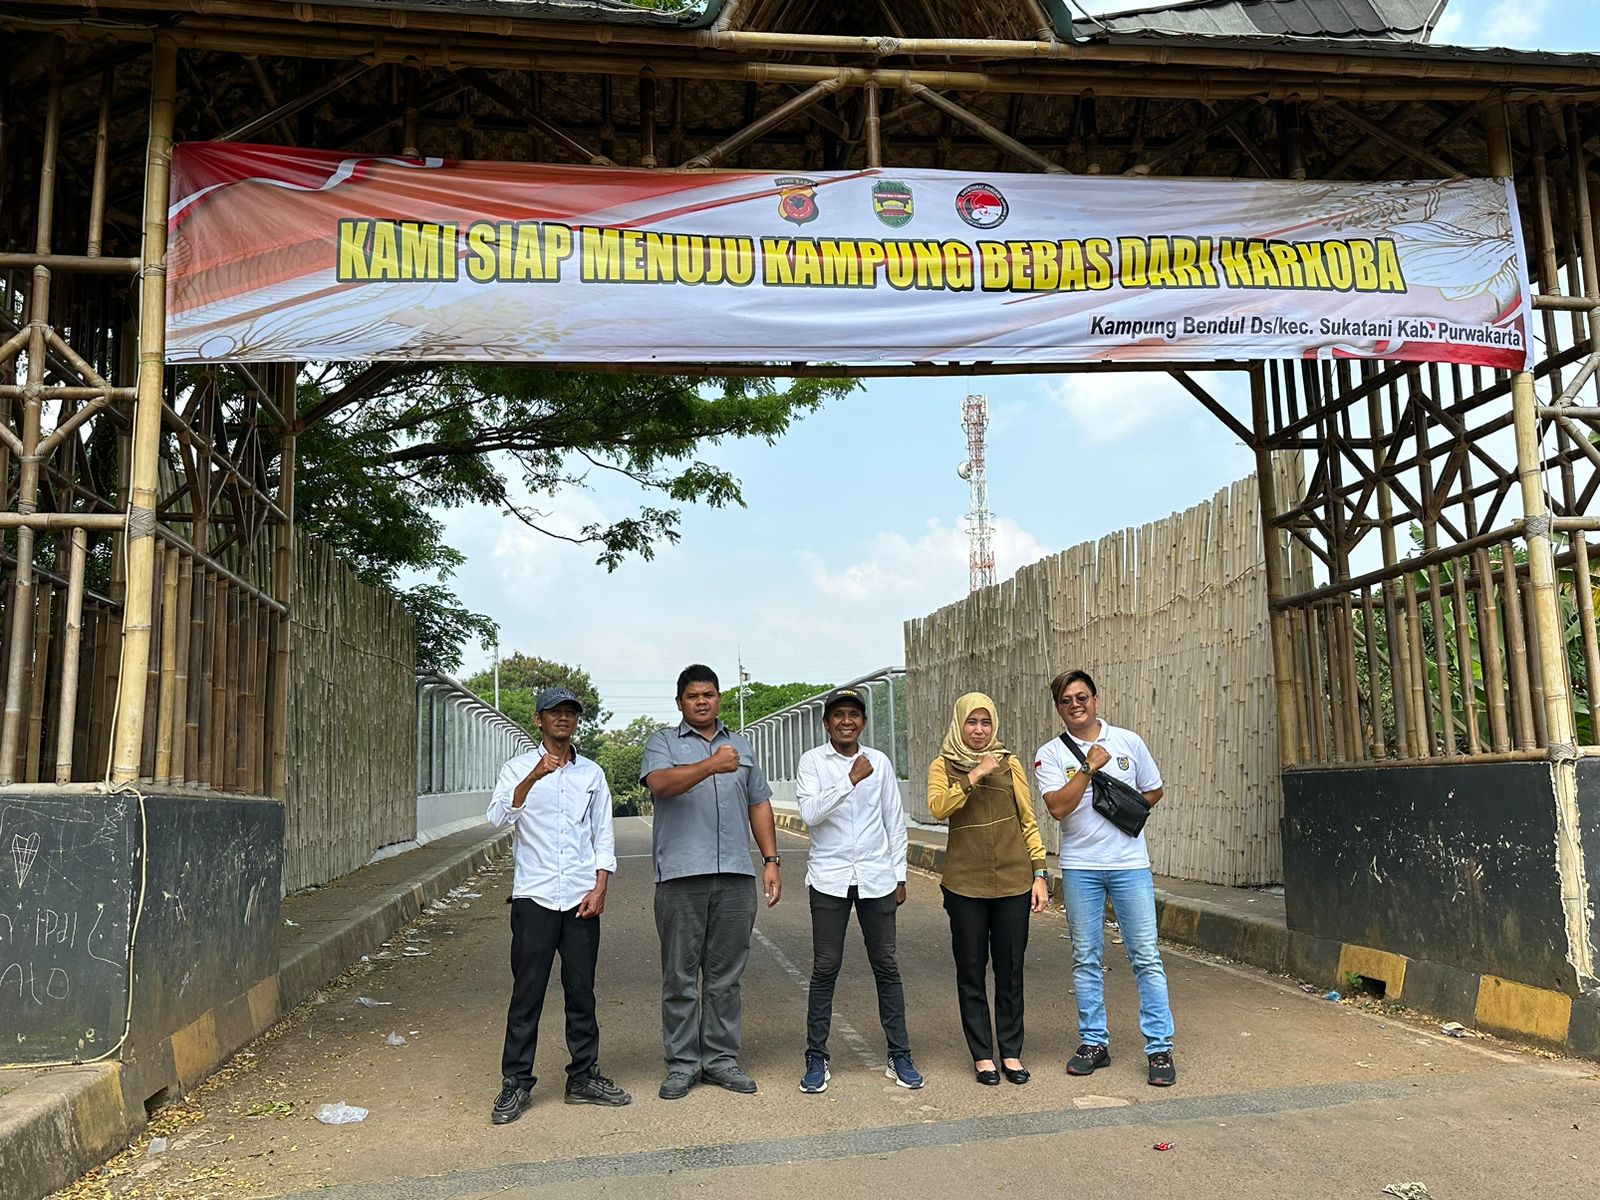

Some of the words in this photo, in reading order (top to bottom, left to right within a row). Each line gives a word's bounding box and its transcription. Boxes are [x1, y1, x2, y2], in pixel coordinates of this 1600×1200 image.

[337, 218, 459, 283] KAMI
[465, 219, 574, 283] SIAP
[580, 225, 756, 286] MENUJU
[760, 236, 975, 291] KAMPUNG
[976, 238, 1113, 293] BEBAS
[1117, 235, 1220, 289] DARI
[1219, 236, 1407, 294] NARKOBA
[1091, 316, 1177, 338] Kampung
[1183, 316, 1245, 334] Bendul
[1250, 316, 1314, 335] Ds/kec.
[1320, 318, 1393, 337] Sukatani
[1397, 320, 1433, 339] Kab.
[1438, 323, 1521, 346] Purwakarta
